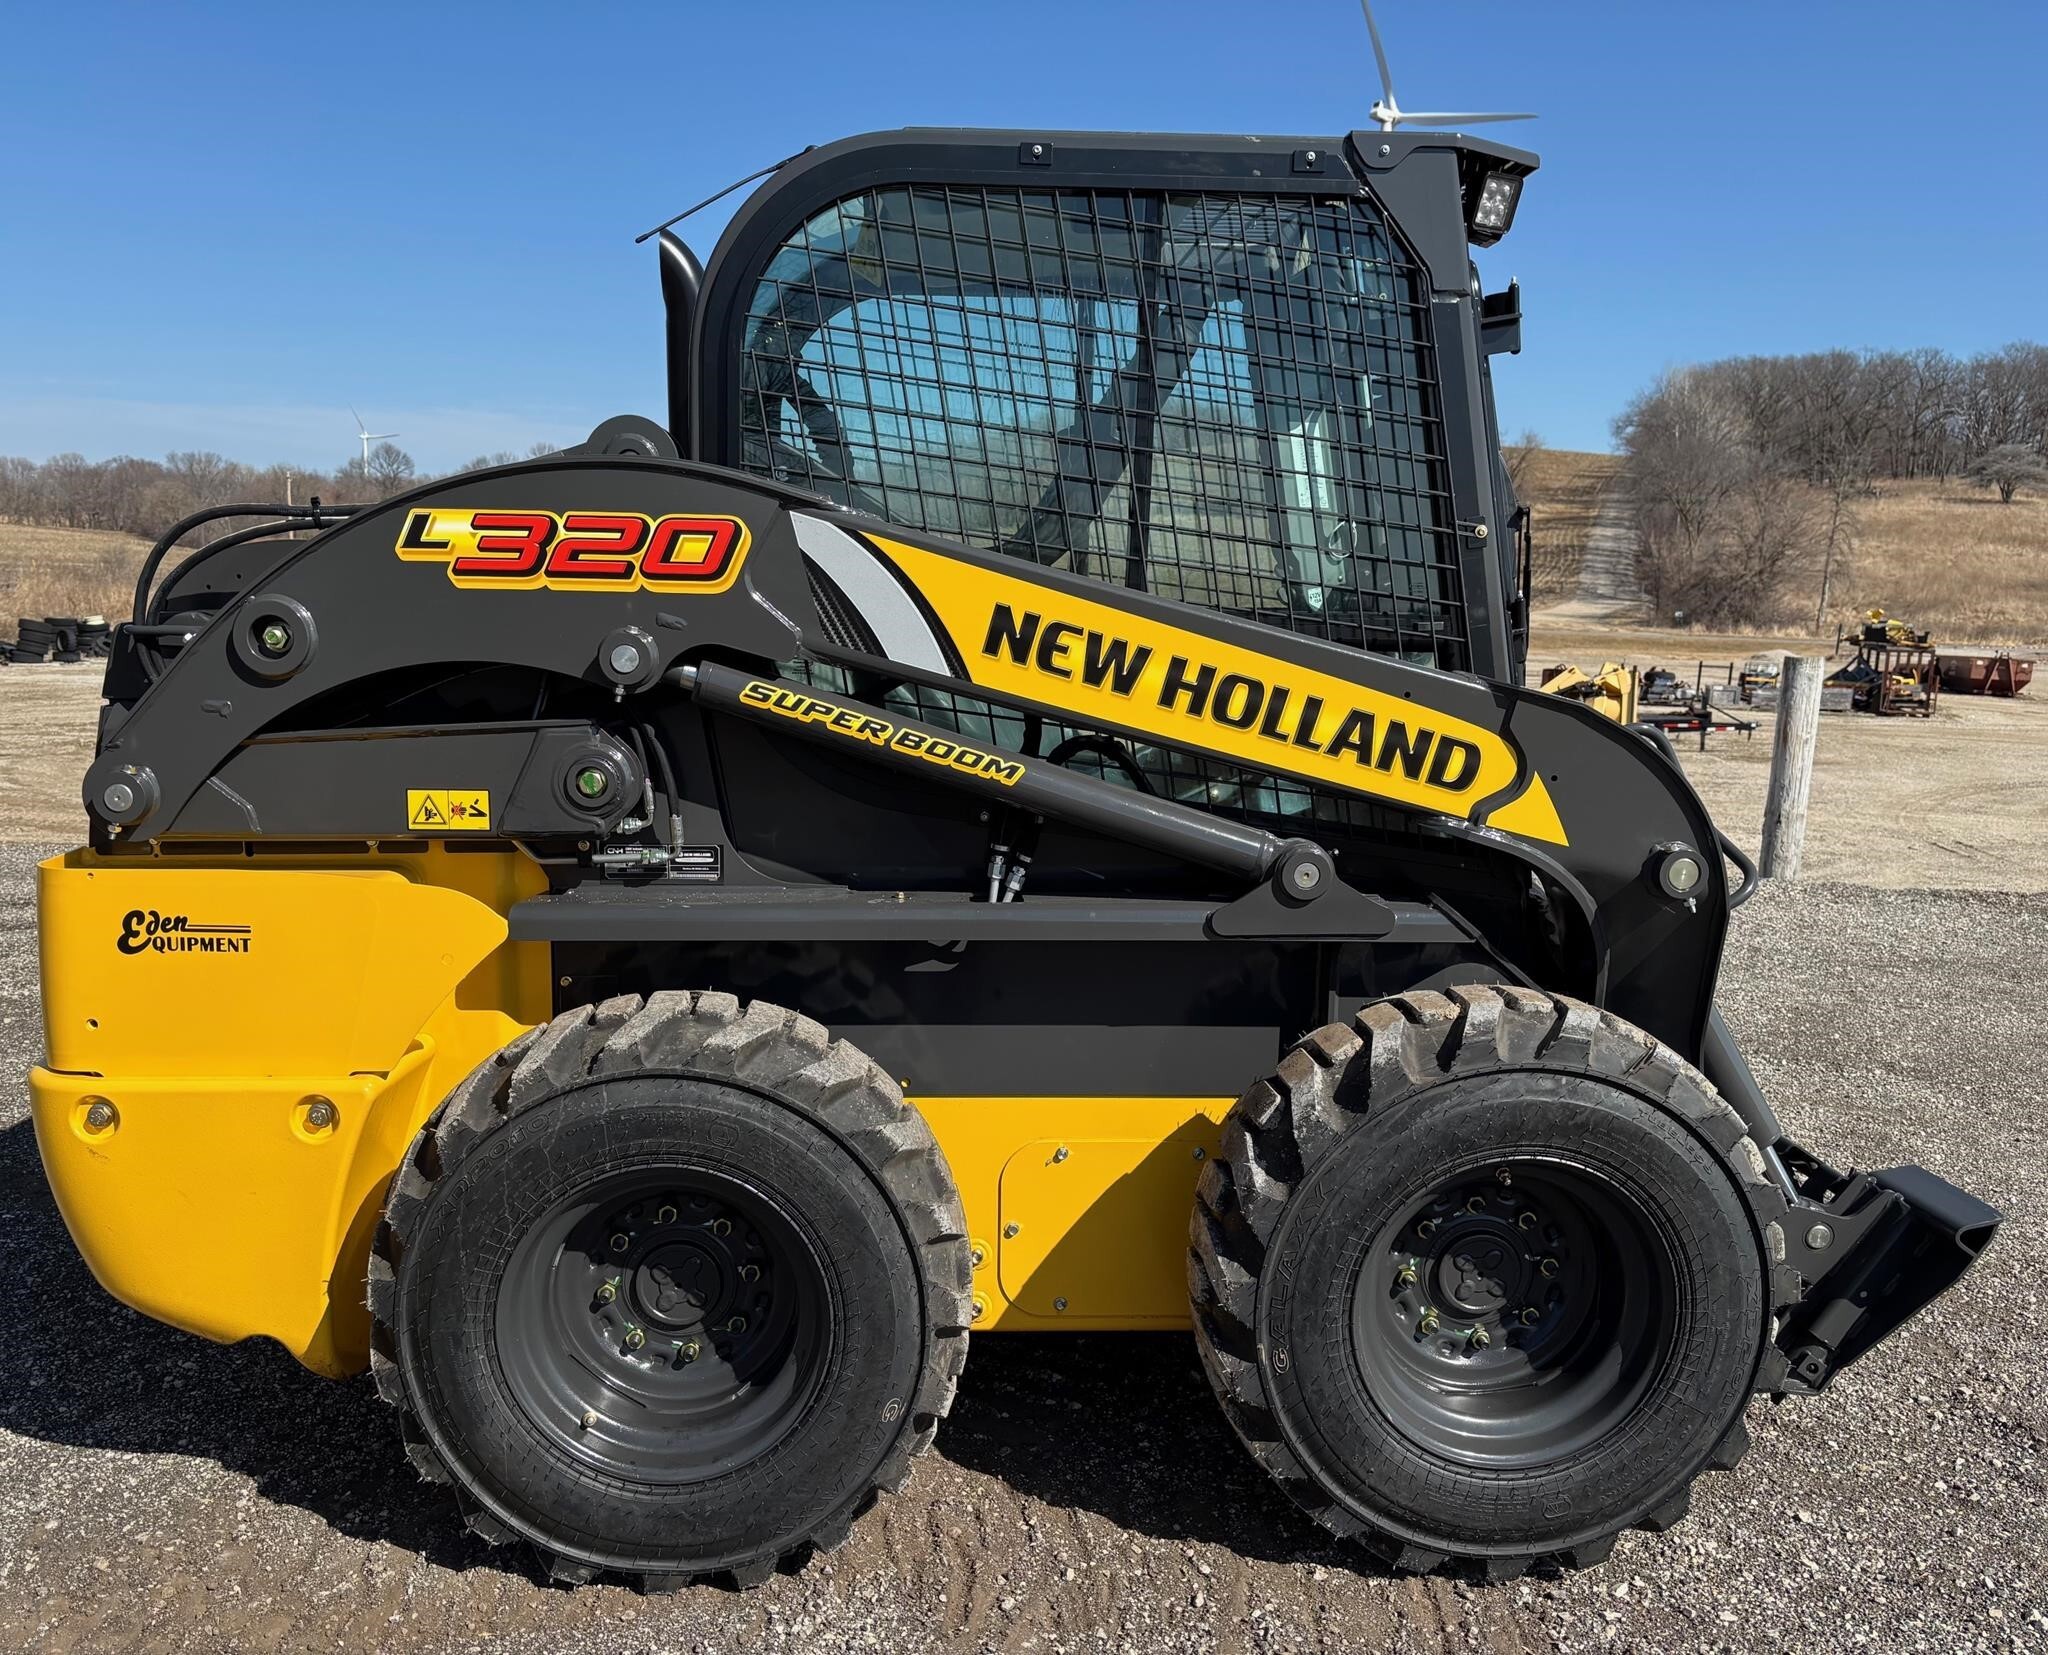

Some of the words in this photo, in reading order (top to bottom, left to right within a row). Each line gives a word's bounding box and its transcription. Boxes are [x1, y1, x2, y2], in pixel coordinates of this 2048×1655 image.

[400, 510, 748, 588] L320
[740, 682, 892, 743] SUPER
[893, 730, 1023, 784] BOOM
[981, 601, 1153, 697] NEW
[1157, 654, 1483, 793] HOLLAND
[117, 909, 188, 955] Eden
[1268, 1180, 1328, 1375] GALAXY
